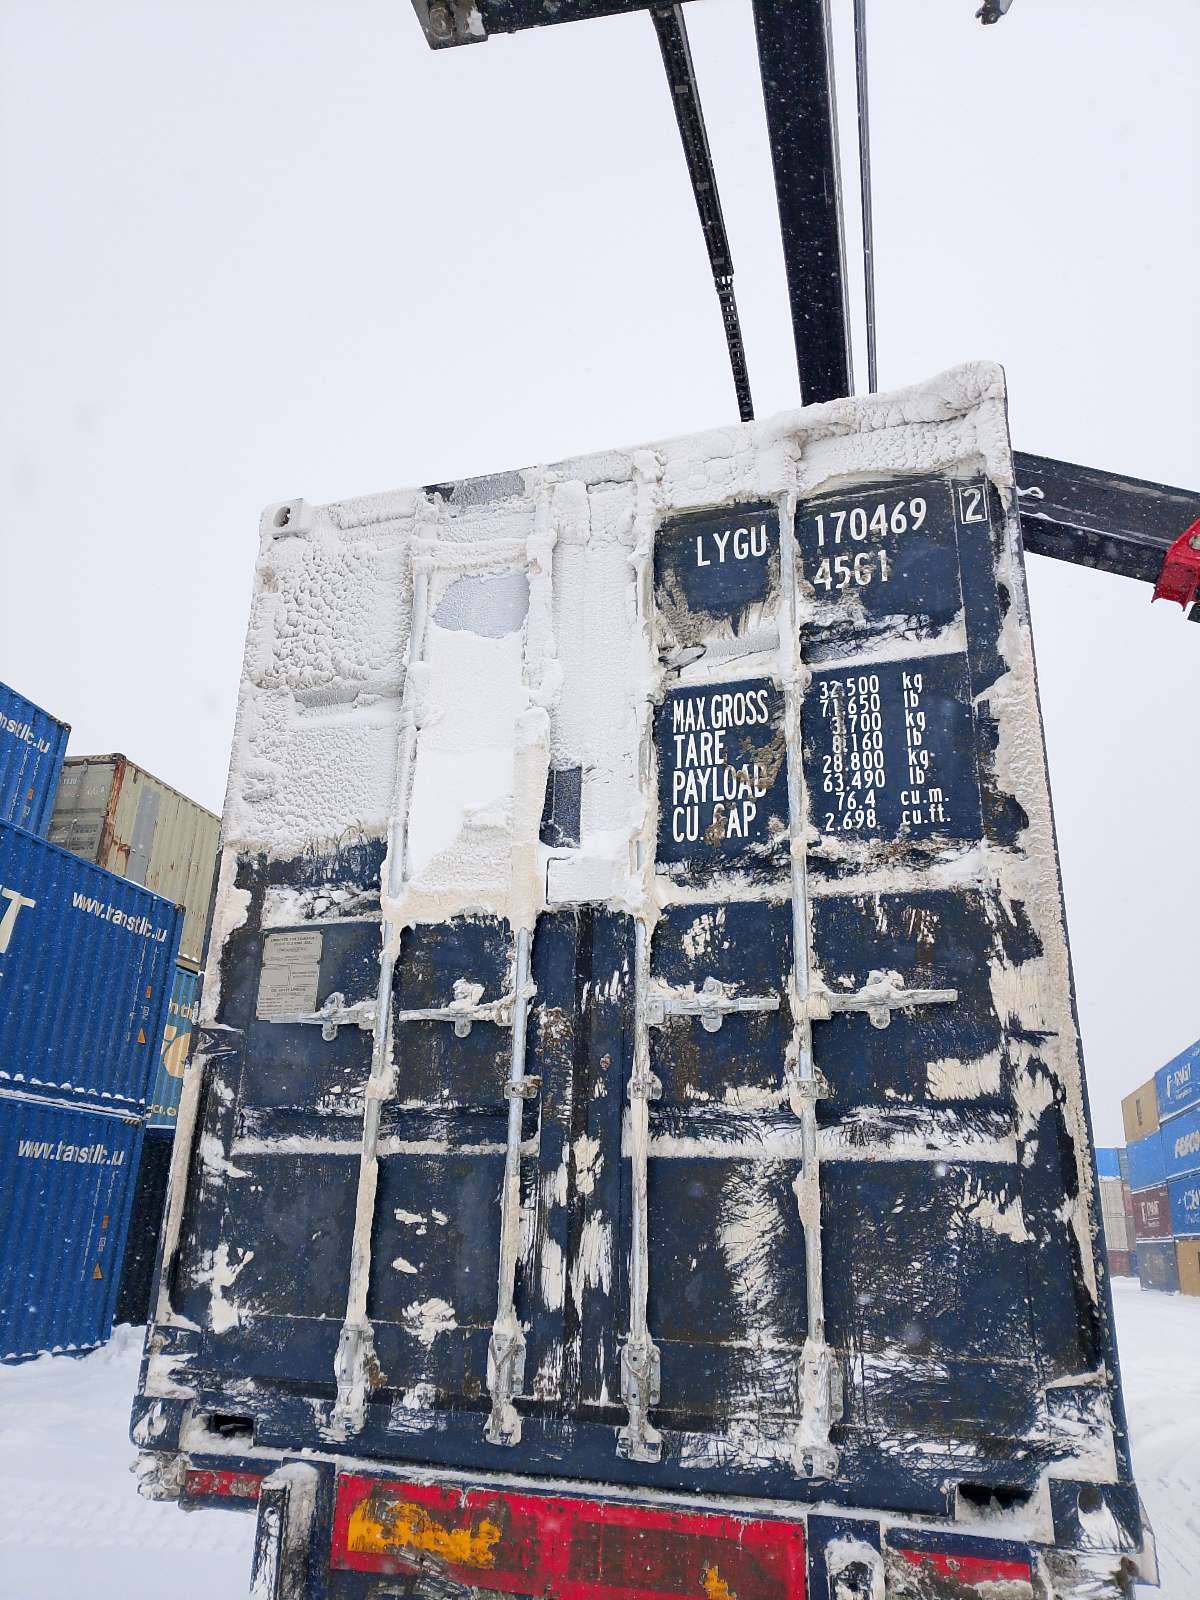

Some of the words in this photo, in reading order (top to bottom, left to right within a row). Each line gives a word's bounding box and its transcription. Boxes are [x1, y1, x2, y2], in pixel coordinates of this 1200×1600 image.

[696, 524, 767, 567] LYGU
[815, 498, 927, 546] 170469
[962, 488, 983, 521] 2
[813, 550, 888, 591] 45G1
[902, 671, 923, 693] kg
[904, 690, 919, 708] lb
[905, 709, 926, 731] kg
[907, 727, 922, 747] lb
[673, 730, 727, 769] TARE
[908, 747, 929, 770] kg
[822, 749, 884, 774] 28.800
[673, 763, 767, 806] PAYLOAD
[823, 768, 886, 793] 63.490
[909, 766, 925, 785] lb
[835, 789, 876, 811] 76.4
[900, 787, 950, 805] cu.m.
[673, 805, 704, 843] CU.
[825, 808, 877, 832] 2.698
